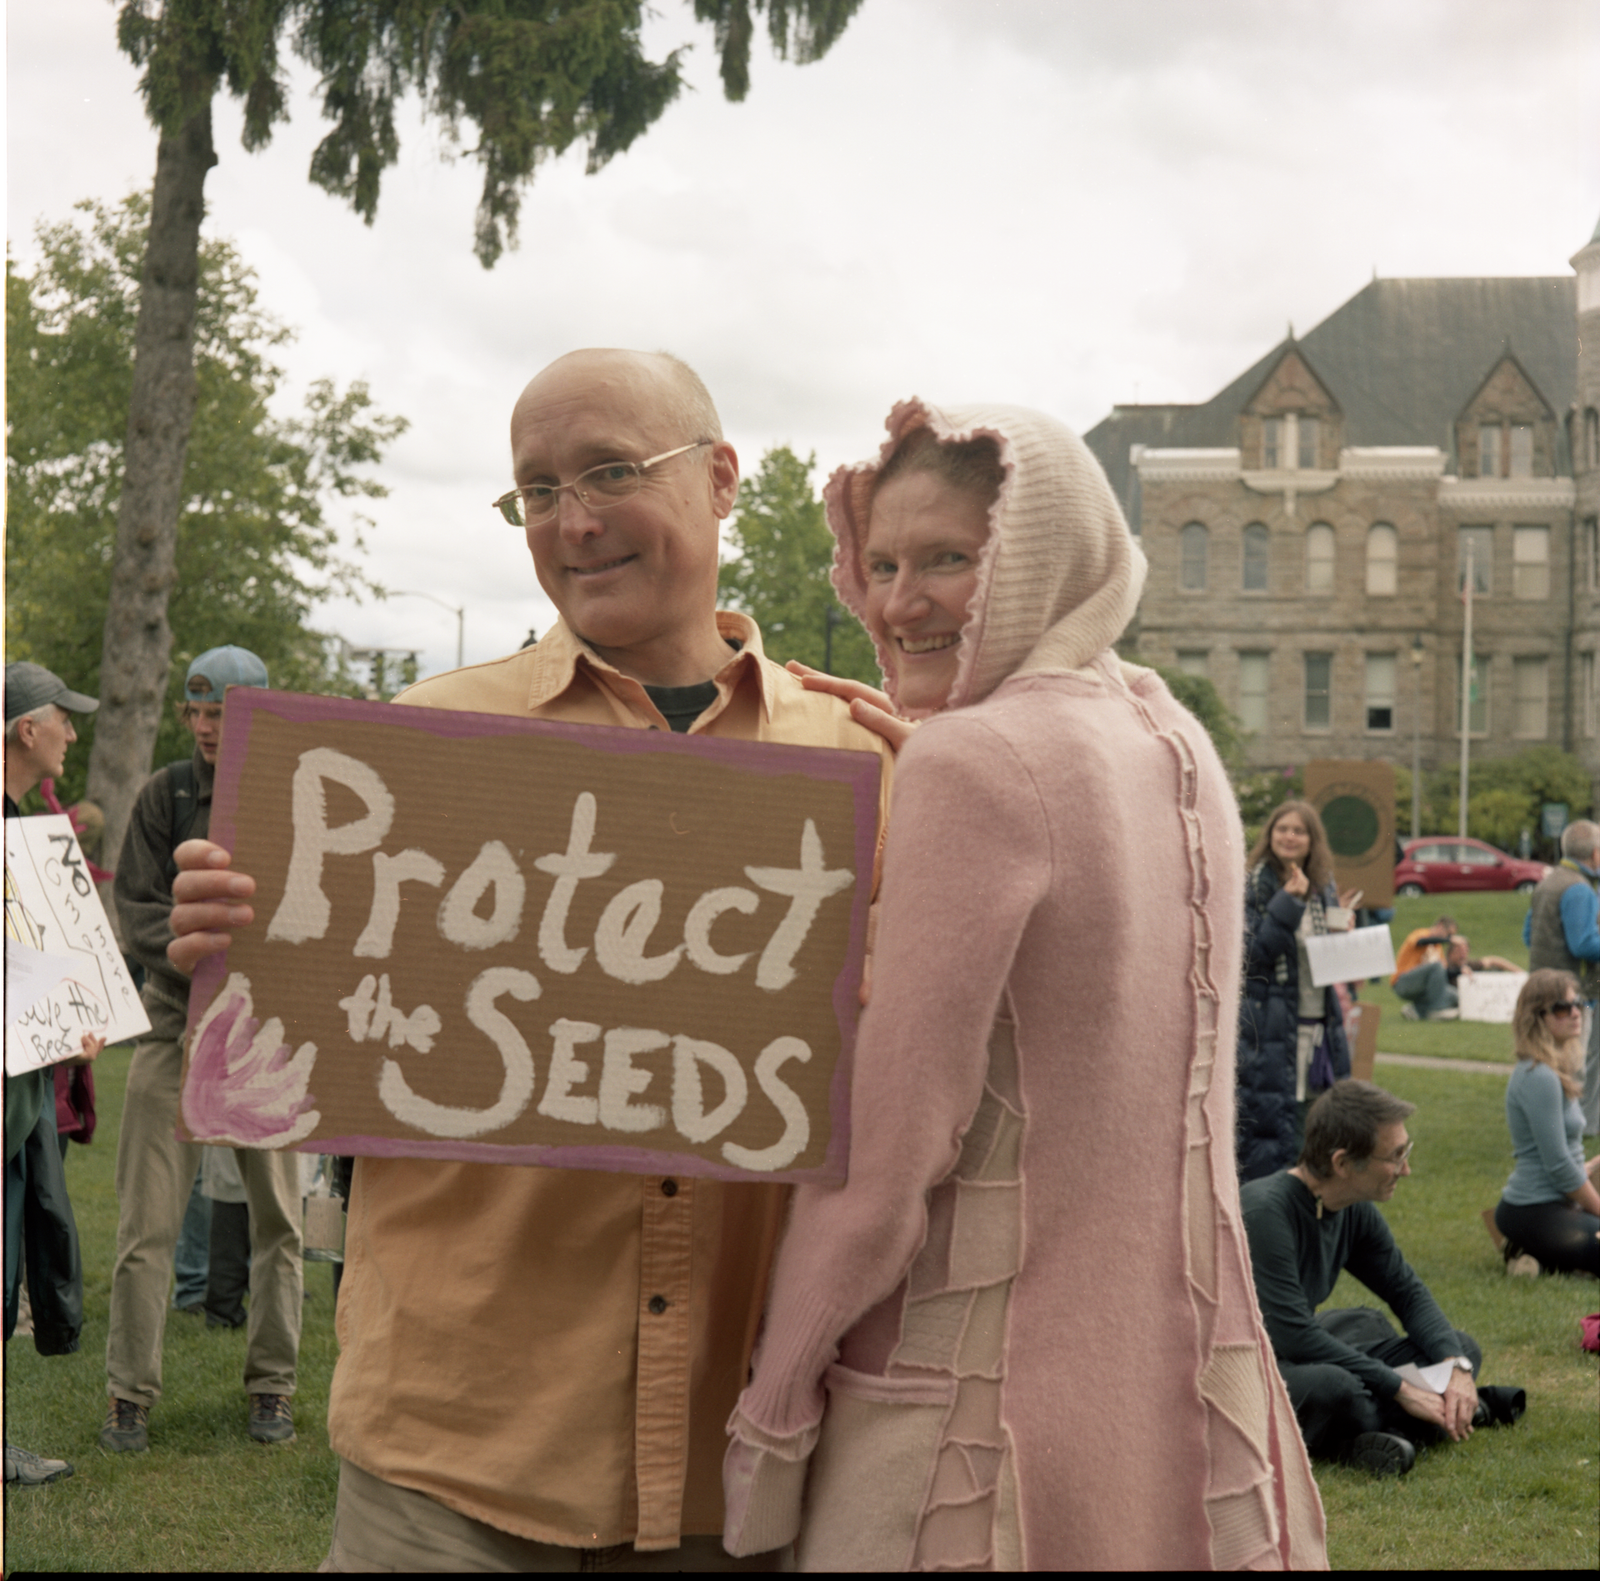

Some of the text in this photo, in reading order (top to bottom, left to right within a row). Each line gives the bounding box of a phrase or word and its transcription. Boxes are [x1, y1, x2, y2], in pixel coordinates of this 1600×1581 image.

[48, 833, 91, 898] NO
[265, 746, 855, 991] Protect
[68, 980, 109, 1027] the
[339, 973, 442, 1053] the
